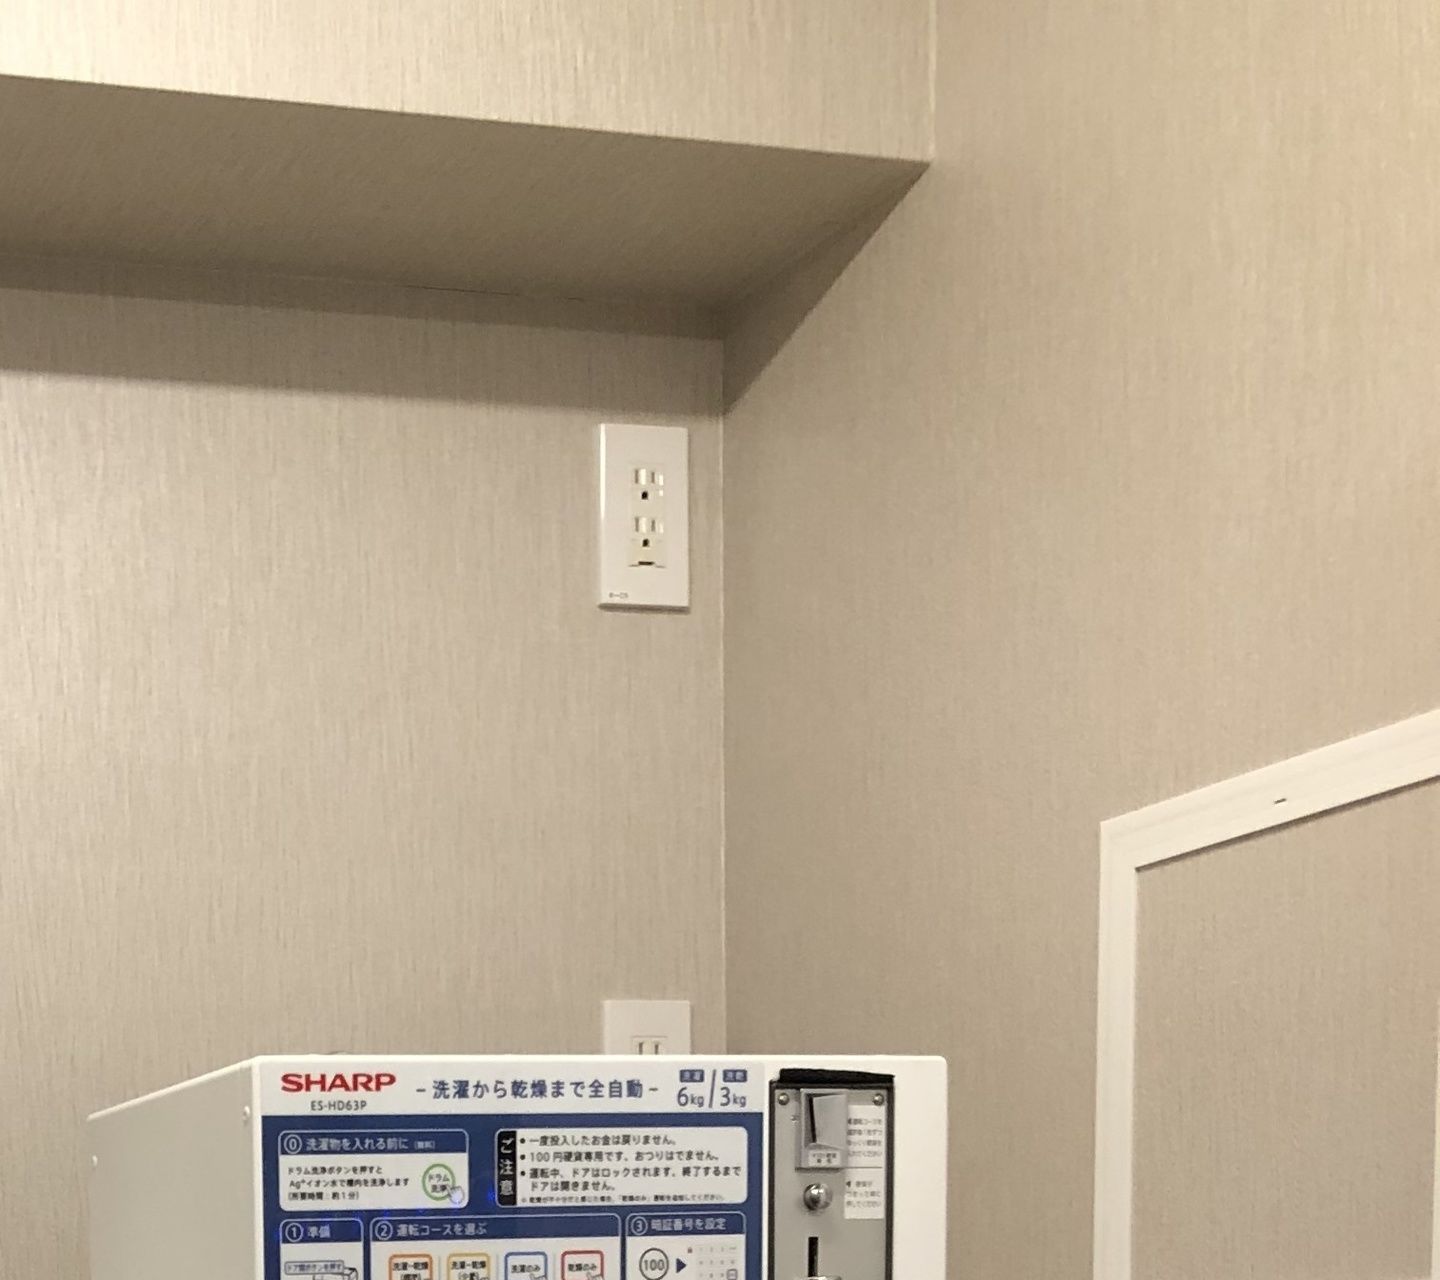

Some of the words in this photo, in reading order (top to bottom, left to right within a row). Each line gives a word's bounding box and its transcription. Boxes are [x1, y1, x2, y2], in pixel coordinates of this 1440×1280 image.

[281, 1073, 396, 1092] SHARP
[432, 1080, 643, 1099] 洗濯から乾燥まで全自動
[678, 1087, 704, 1107] 6kg
[720, 1087, 746, 1107] 3kg
[311, 1101, 367, 1111] ES-HD63P
[306, 1138, 408, 1150] 洗濯物を入れる前に
[530, 1135, 676, 1147] 一度投入したお金は戻りません。
[499, 1138, 514, 1196] ご注意
[428, 1174, 450, 1182] ドラム
[530, 1181, 616, 1191] ドアは開きません。
[397, 1223, 488, 1236] 運転コースを選ぶ
[651, 1218, 726, 1230] 暗証番号を設定
[308, 1225, 331, 1238] 準備
[511, 1264, 541, 1273] 洗濯のみ
[644, 1260, 665, 1270] 100
